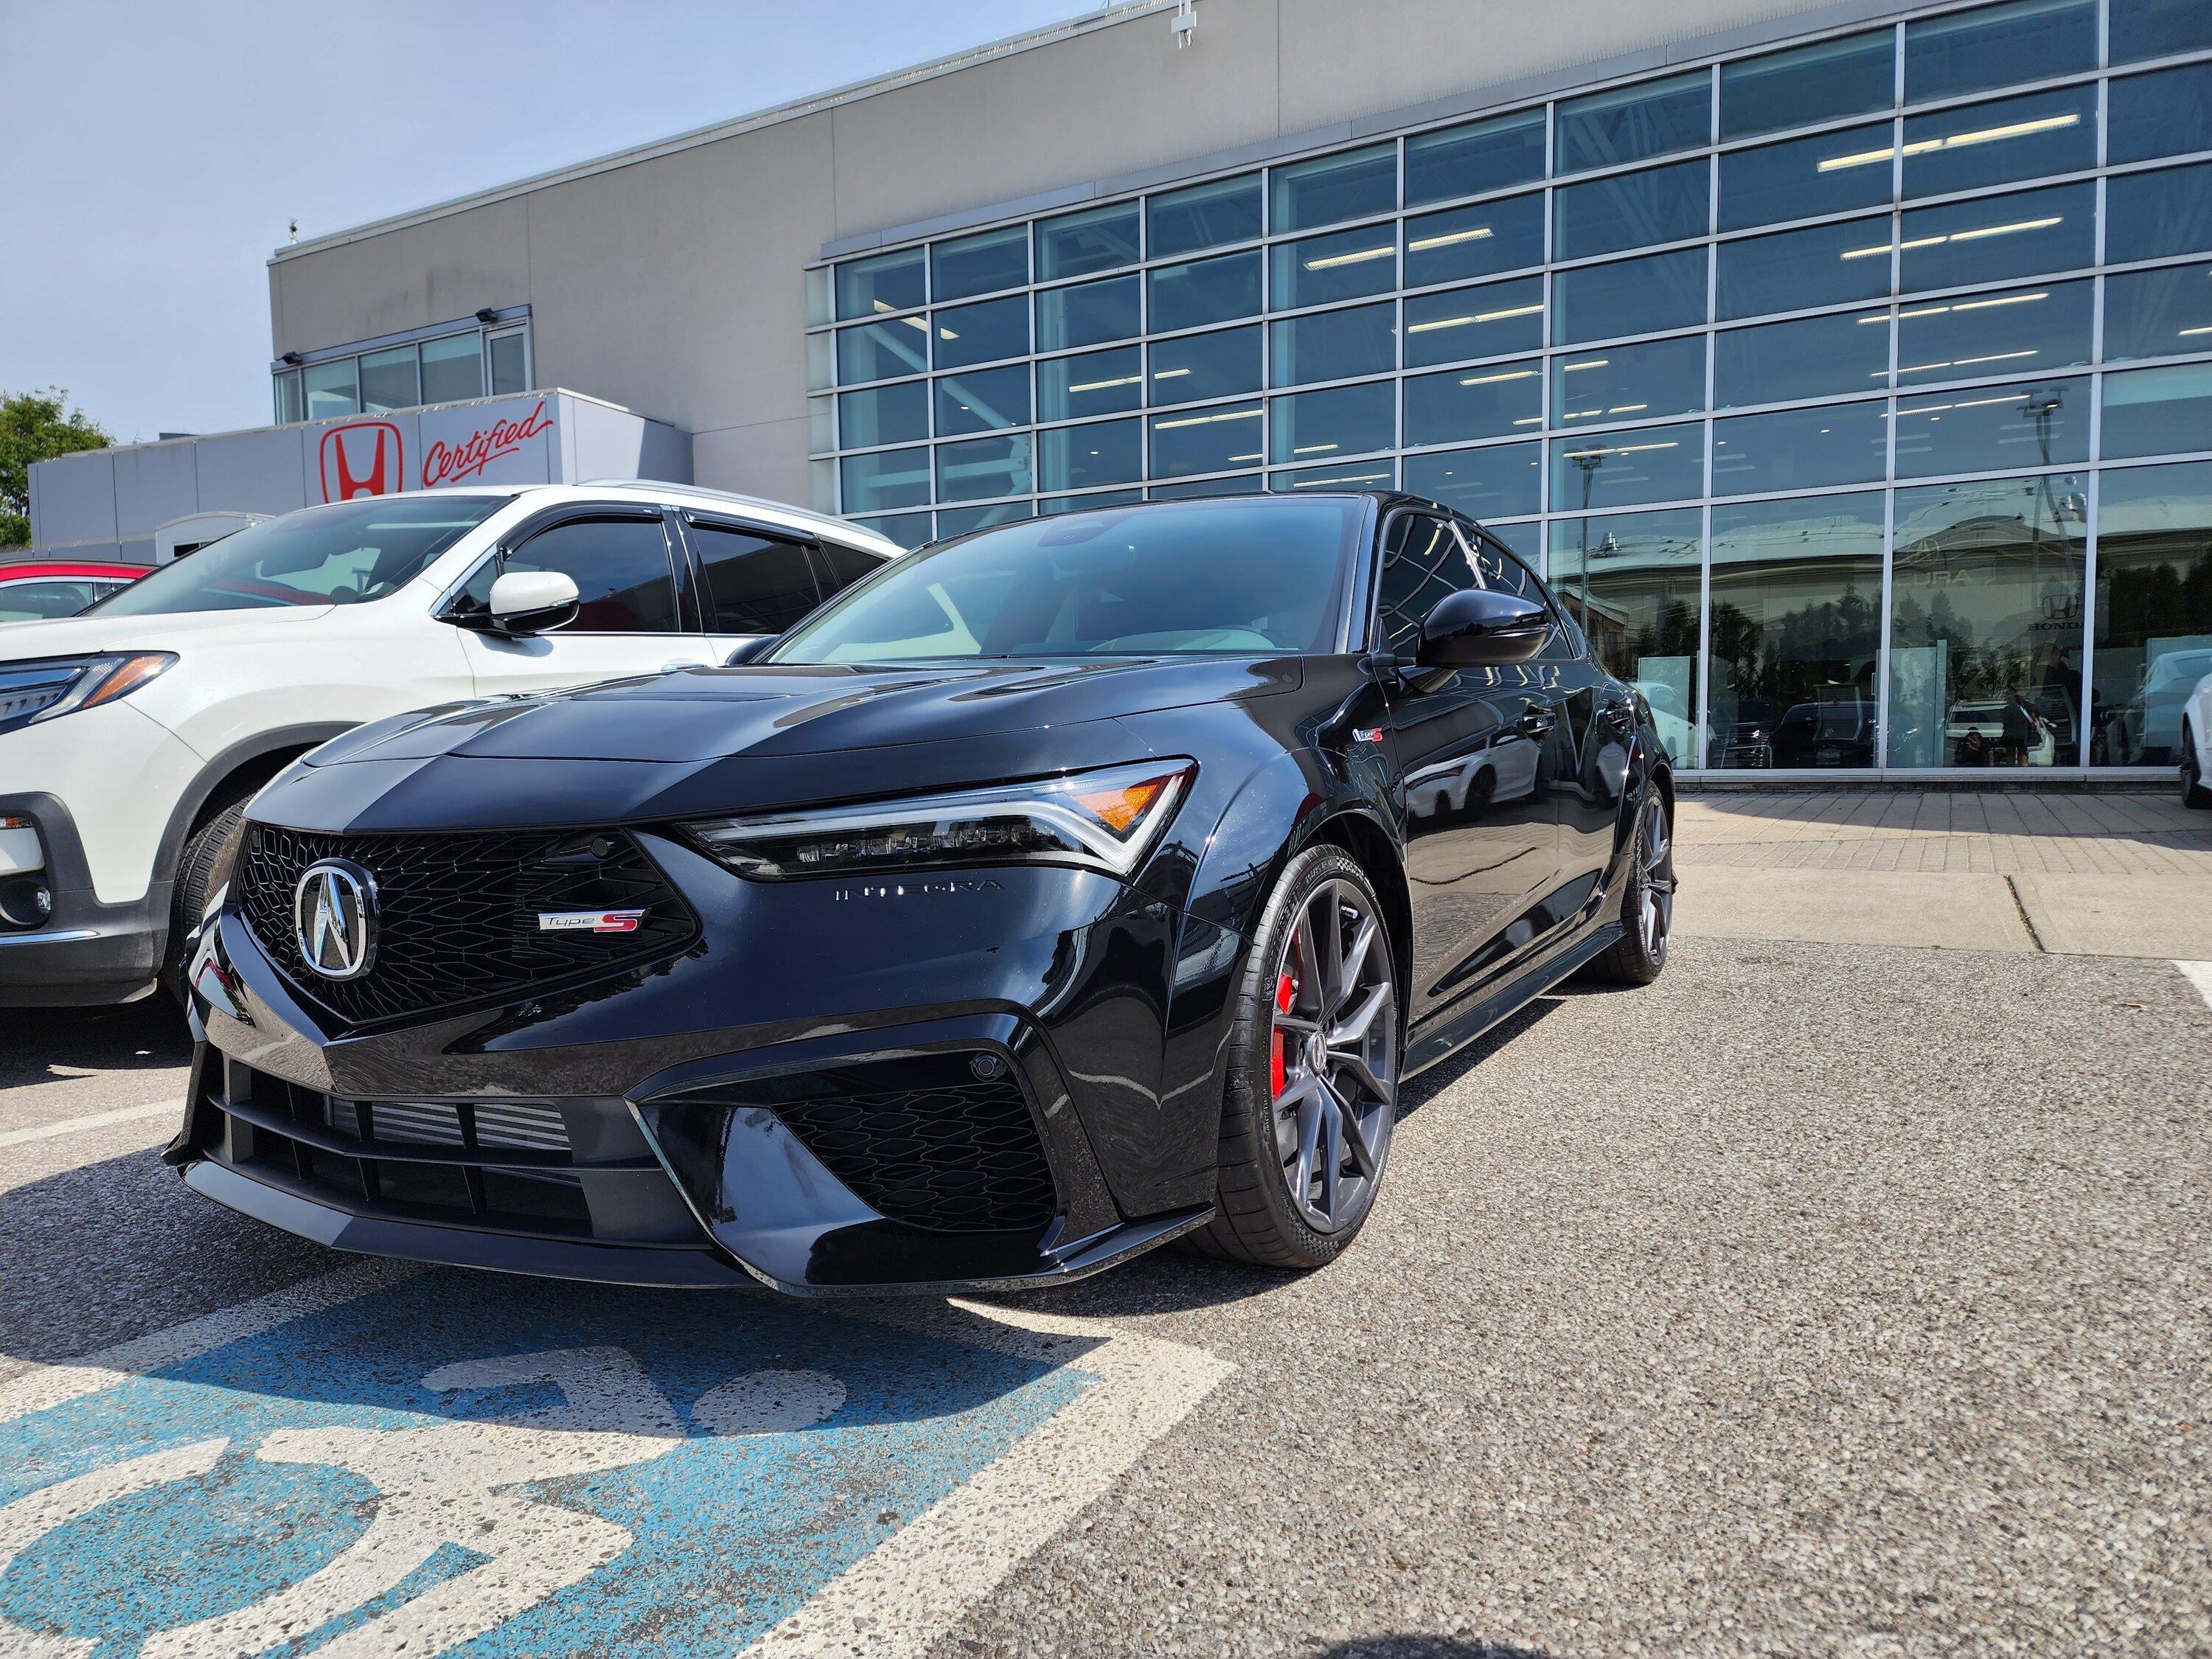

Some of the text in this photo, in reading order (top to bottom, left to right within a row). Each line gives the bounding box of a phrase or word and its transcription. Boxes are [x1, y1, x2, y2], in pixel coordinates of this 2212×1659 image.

[422, 401, 554, 487] Certified
[835, 880, 1004, 901] INTEGRA
[544, 912, 641, 933] Type S
